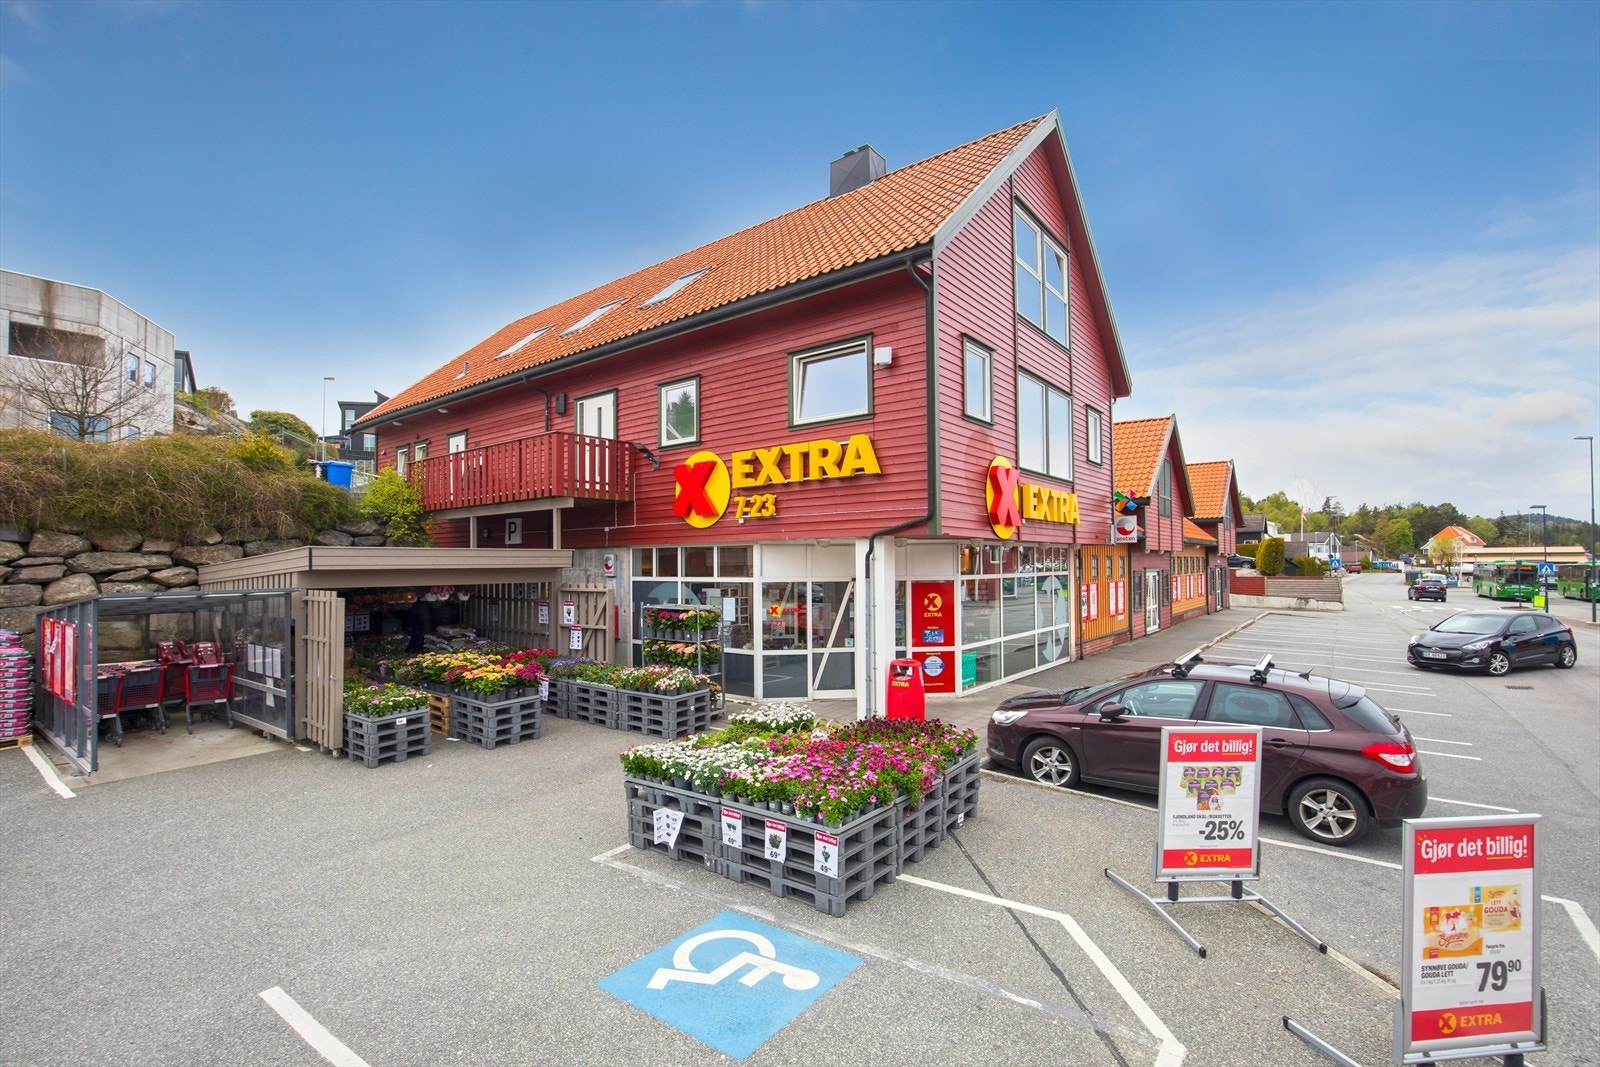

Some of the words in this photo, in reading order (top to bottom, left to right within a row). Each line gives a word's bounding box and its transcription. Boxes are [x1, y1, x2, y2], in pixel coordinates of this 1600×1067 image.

[731, 433, 882, 489] EXTRA
[734, 493, 776, 519] 7-23
[1022, 483, 1081, 525] EXTRA
[508, 521, 517, 542] P
[1116, 535, 1136, 543] posten
[1174, 739, 1198, 755] Gjør
[1201, 739, 1220, 753] det
[1222, 739, 1253, 755] billig!
[1199, 820, 1245, 840] -25%
[1421, 838, 1454, 863] Gjør
[1457, 837, 1483, 857] det
[1486, 835, 1528, 859] billig!
[1200, 854, 1231, 862] EXTRA
[1484, 906, 1508, 914] GOUDA
[1420, 971, 1440, 979] GOUDA
[1421, 963, 1447, 972] SYNNØVE
[1460, 1013, 1503, 1027] EXTRA
